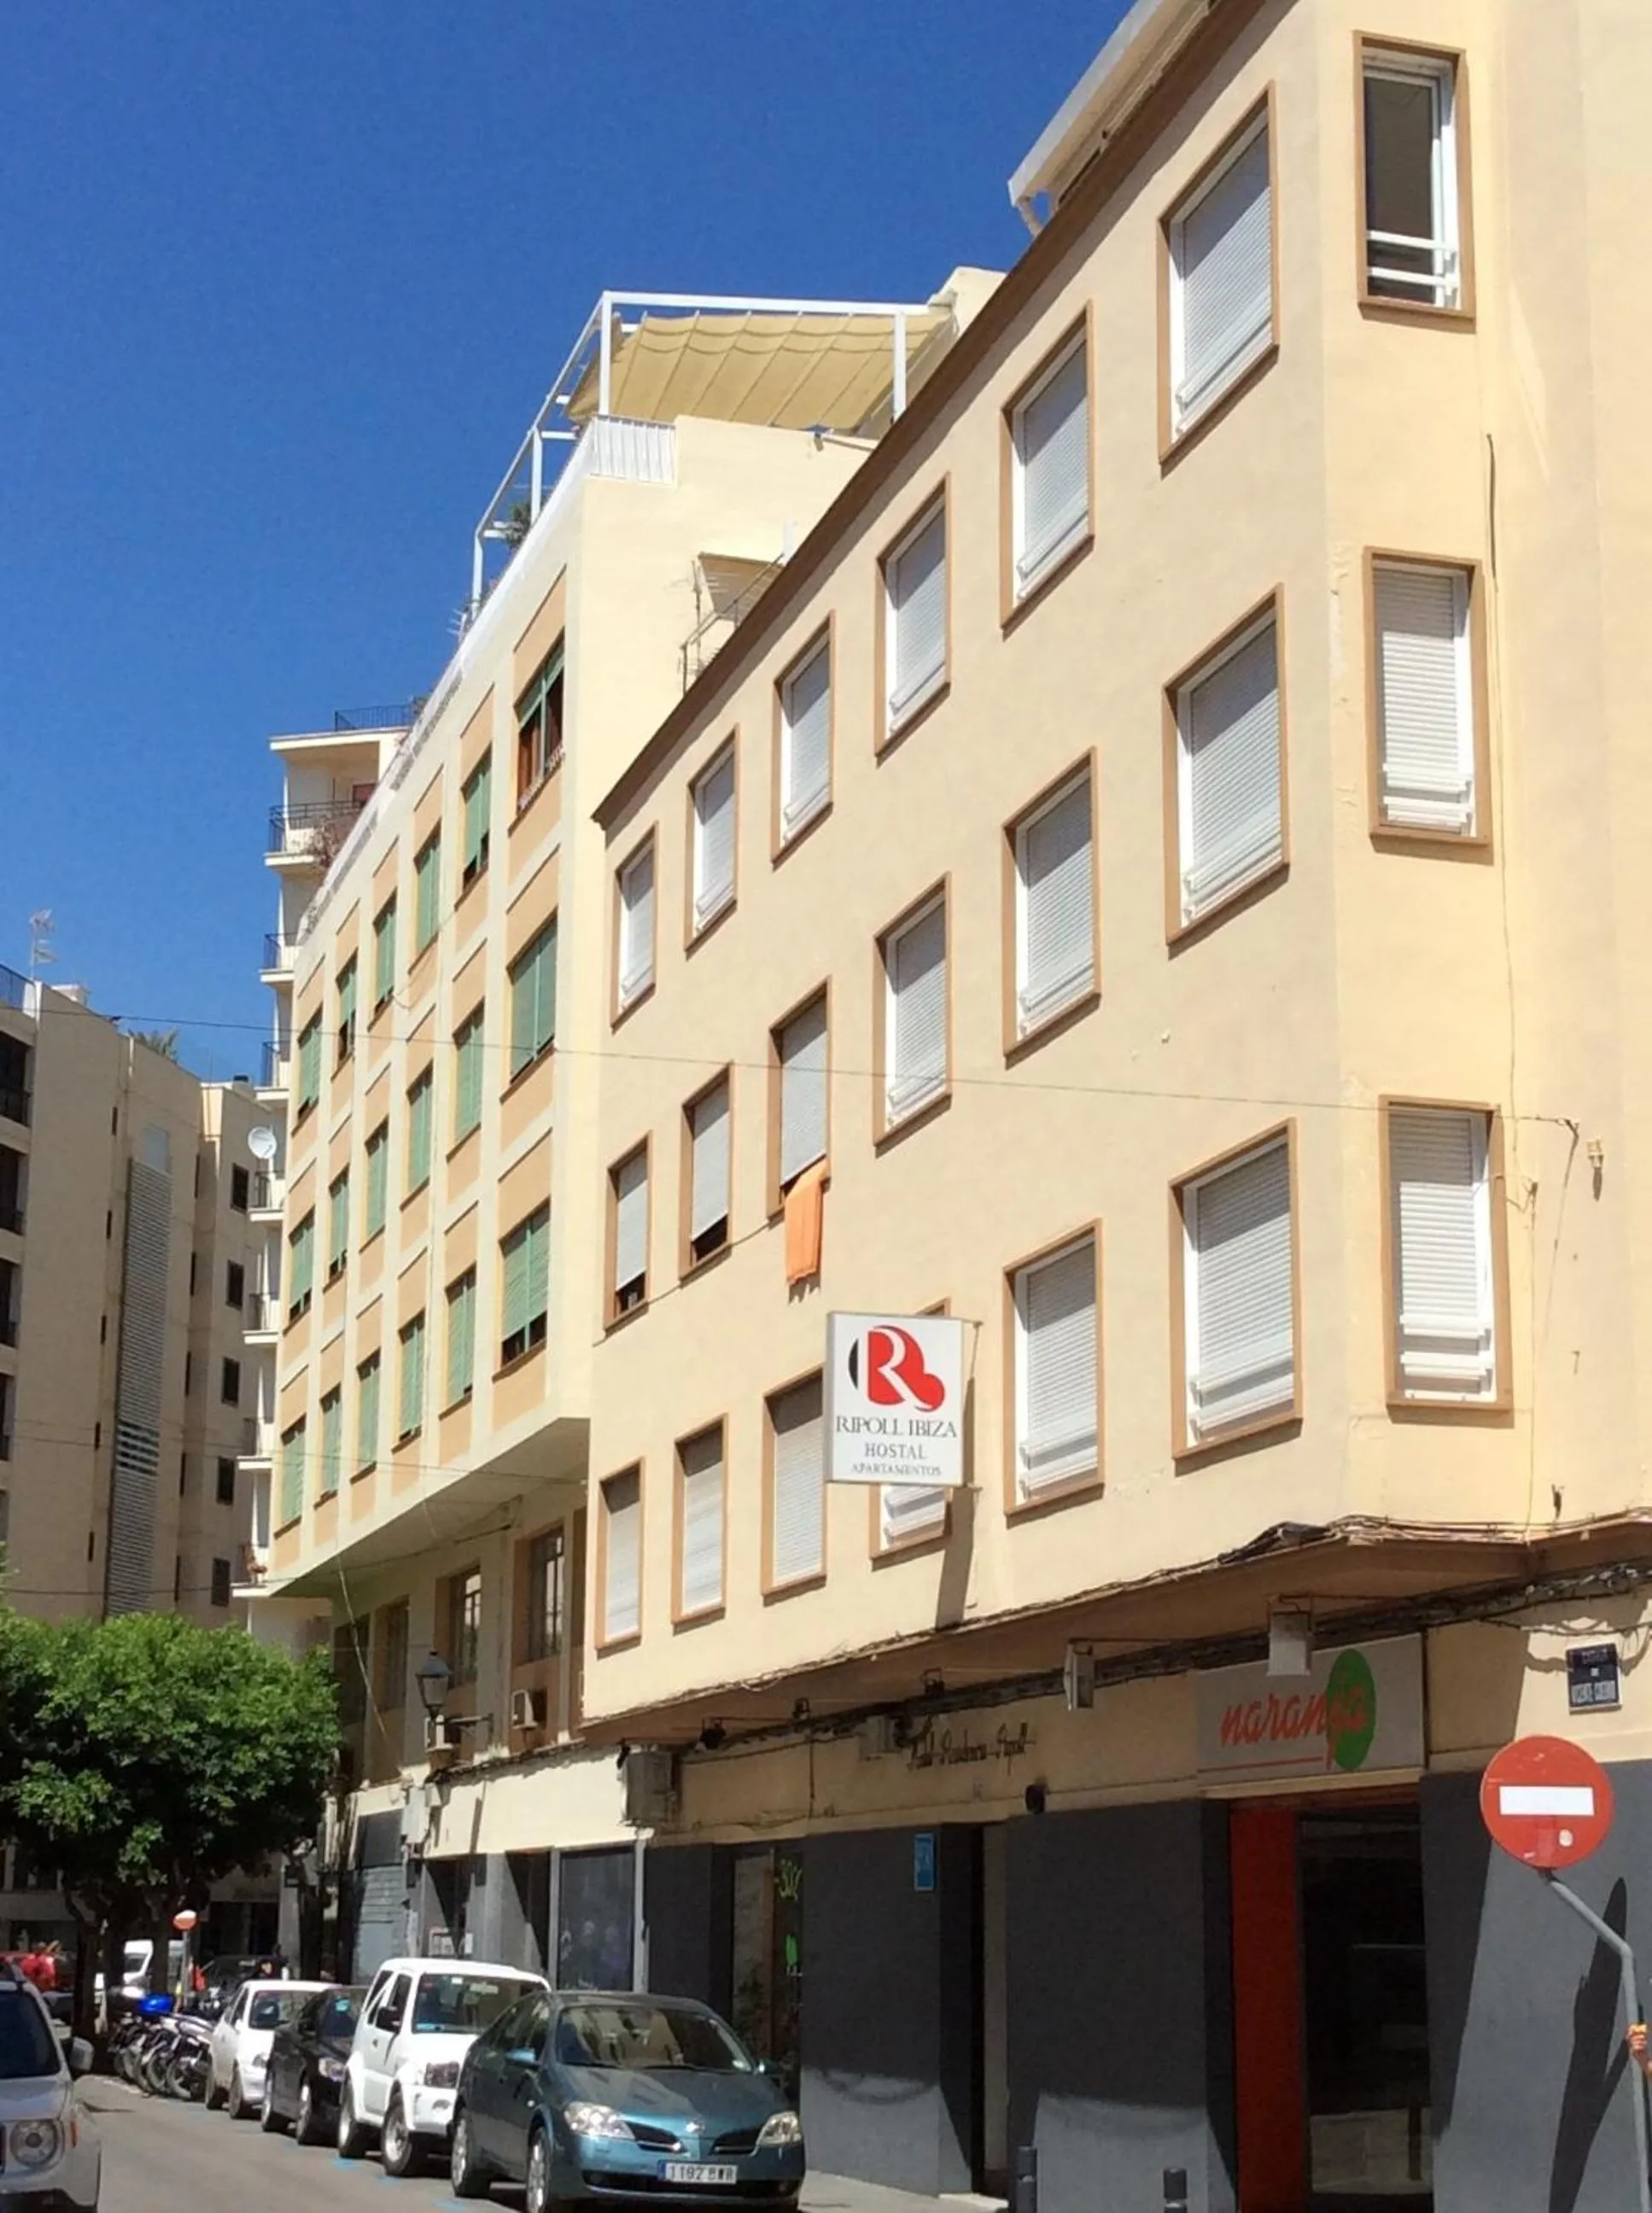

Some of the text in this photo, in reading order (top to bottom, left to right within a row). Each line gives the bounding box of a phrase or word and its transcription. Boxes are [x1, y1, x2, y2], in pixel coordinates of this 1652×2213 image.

[836, 1416, 957, 1438] RIPOLL IBIZA
[865, 1442, 927, 1459] HOSTAL
[851, 1462, 942, 1476] APARTAMENTOS
